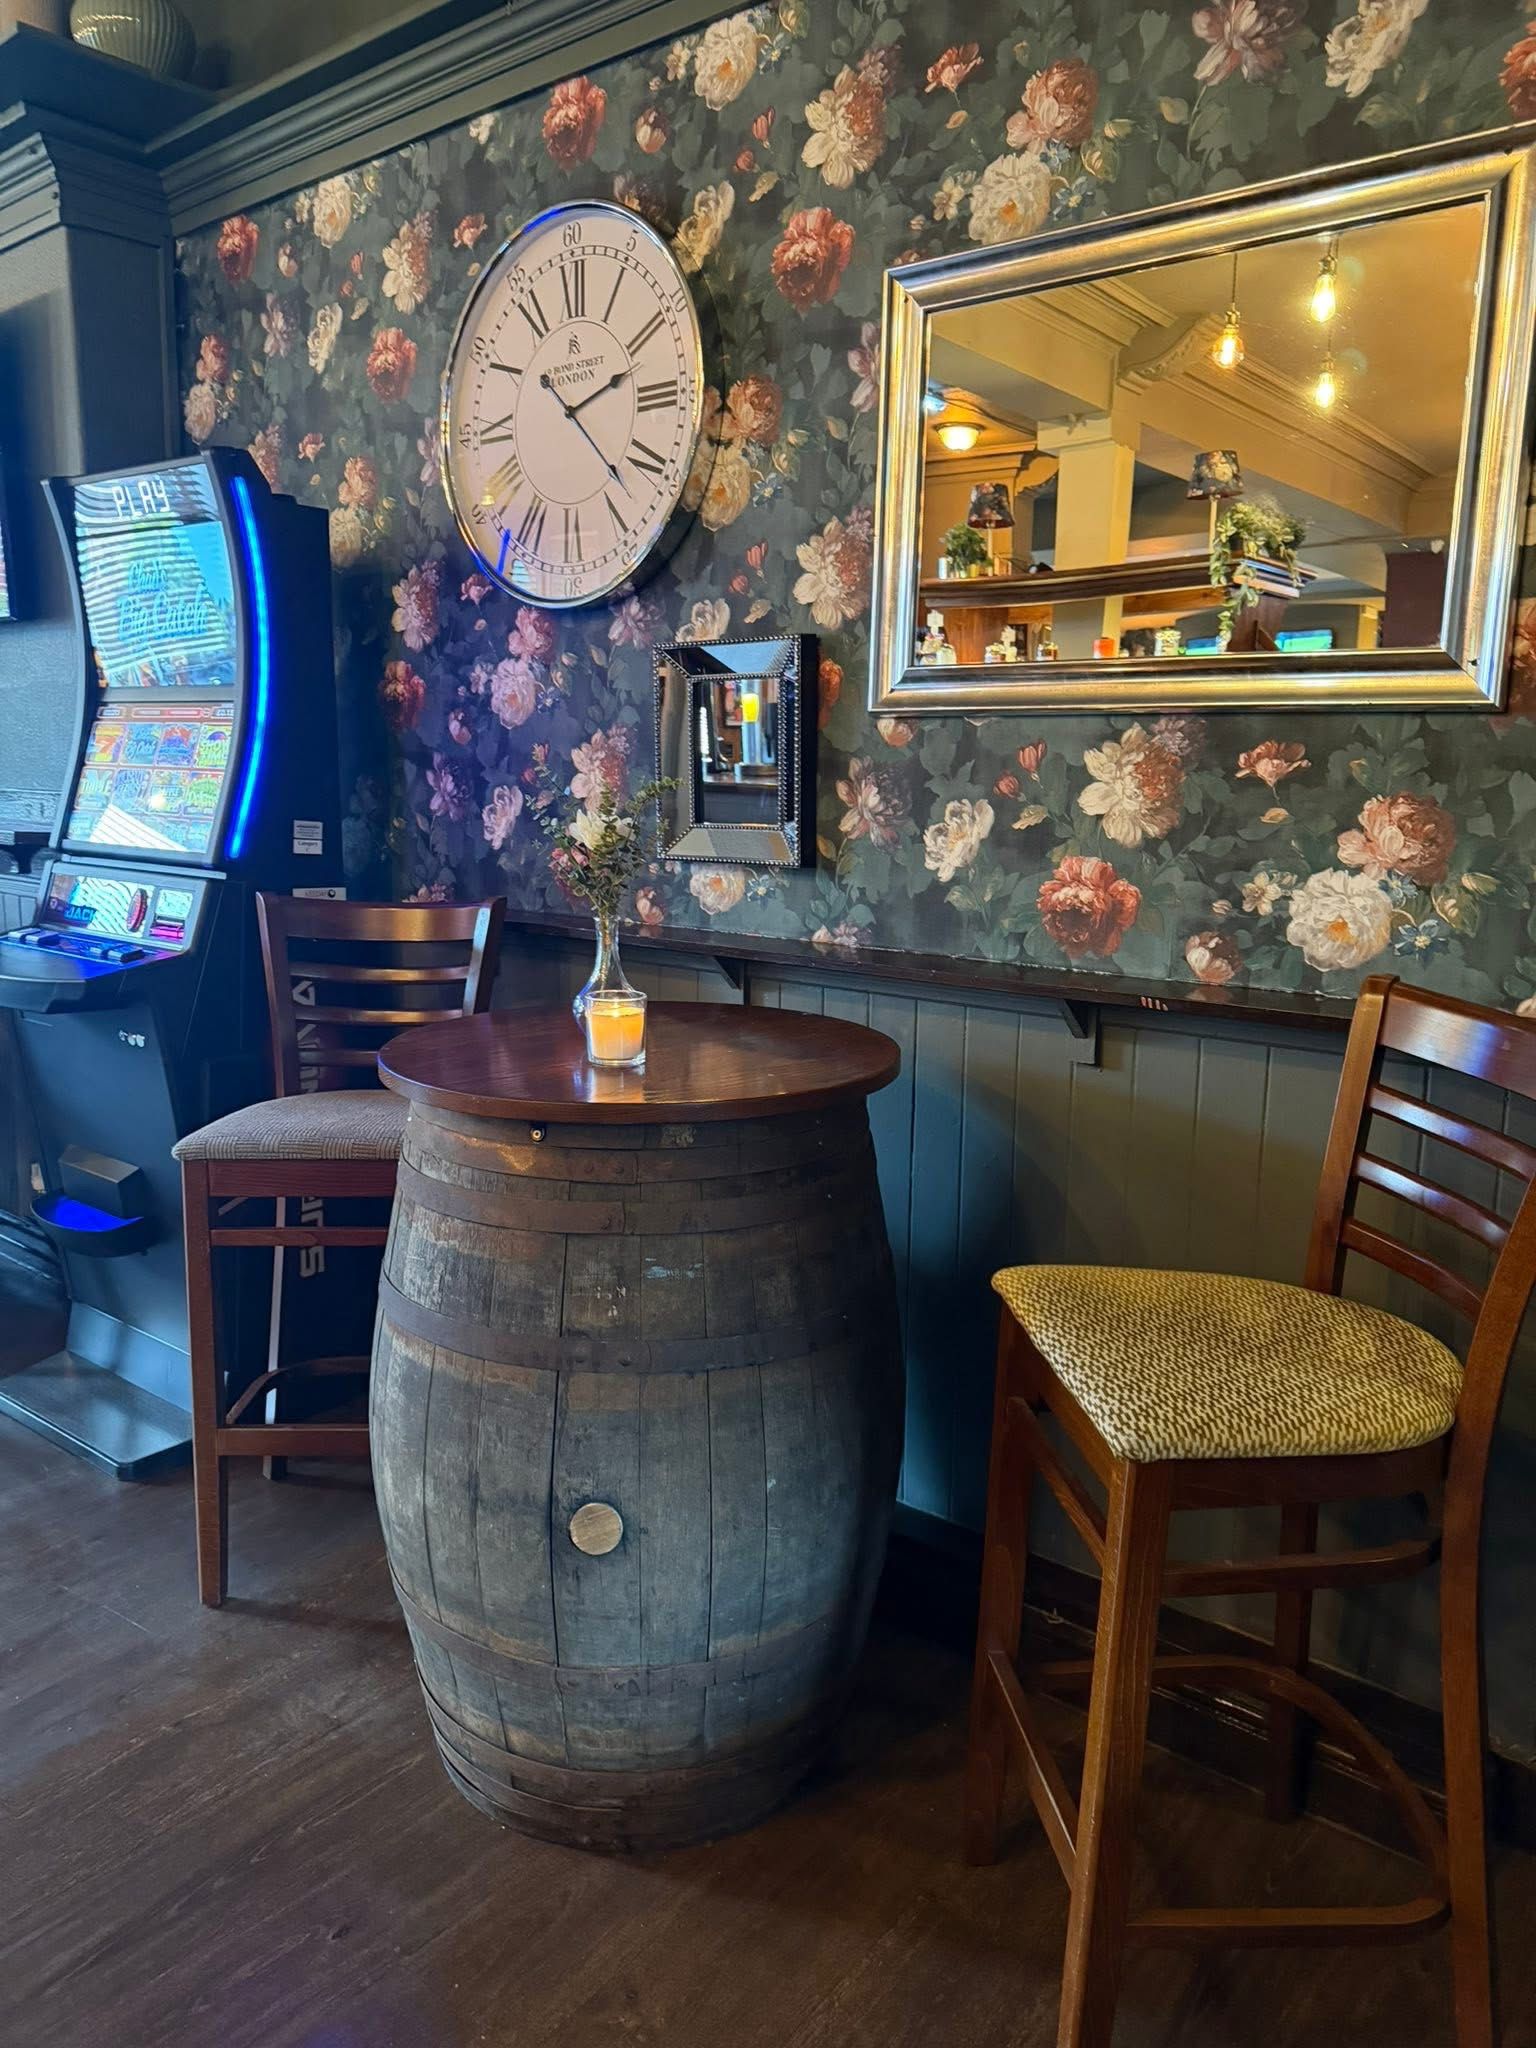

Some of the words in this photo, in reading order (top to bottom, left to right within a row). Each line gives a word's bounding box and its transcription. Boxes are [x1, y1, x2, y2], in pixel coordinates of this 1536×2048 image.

[562, 222, 582, 248] 60
[626, 230, 639, 252] 5
[506, 263, 526, 292] 55
[670, 287, 688, 313] 10
[469, 336, 487, 365] 50
[576, 355, 605, 369] STREET
[551, 369, 595, 387] LONDON
[460, 423, 472, 448] 45
[113, 479, 170, 518] PLAY
[563, 576, 583, 597] 30
